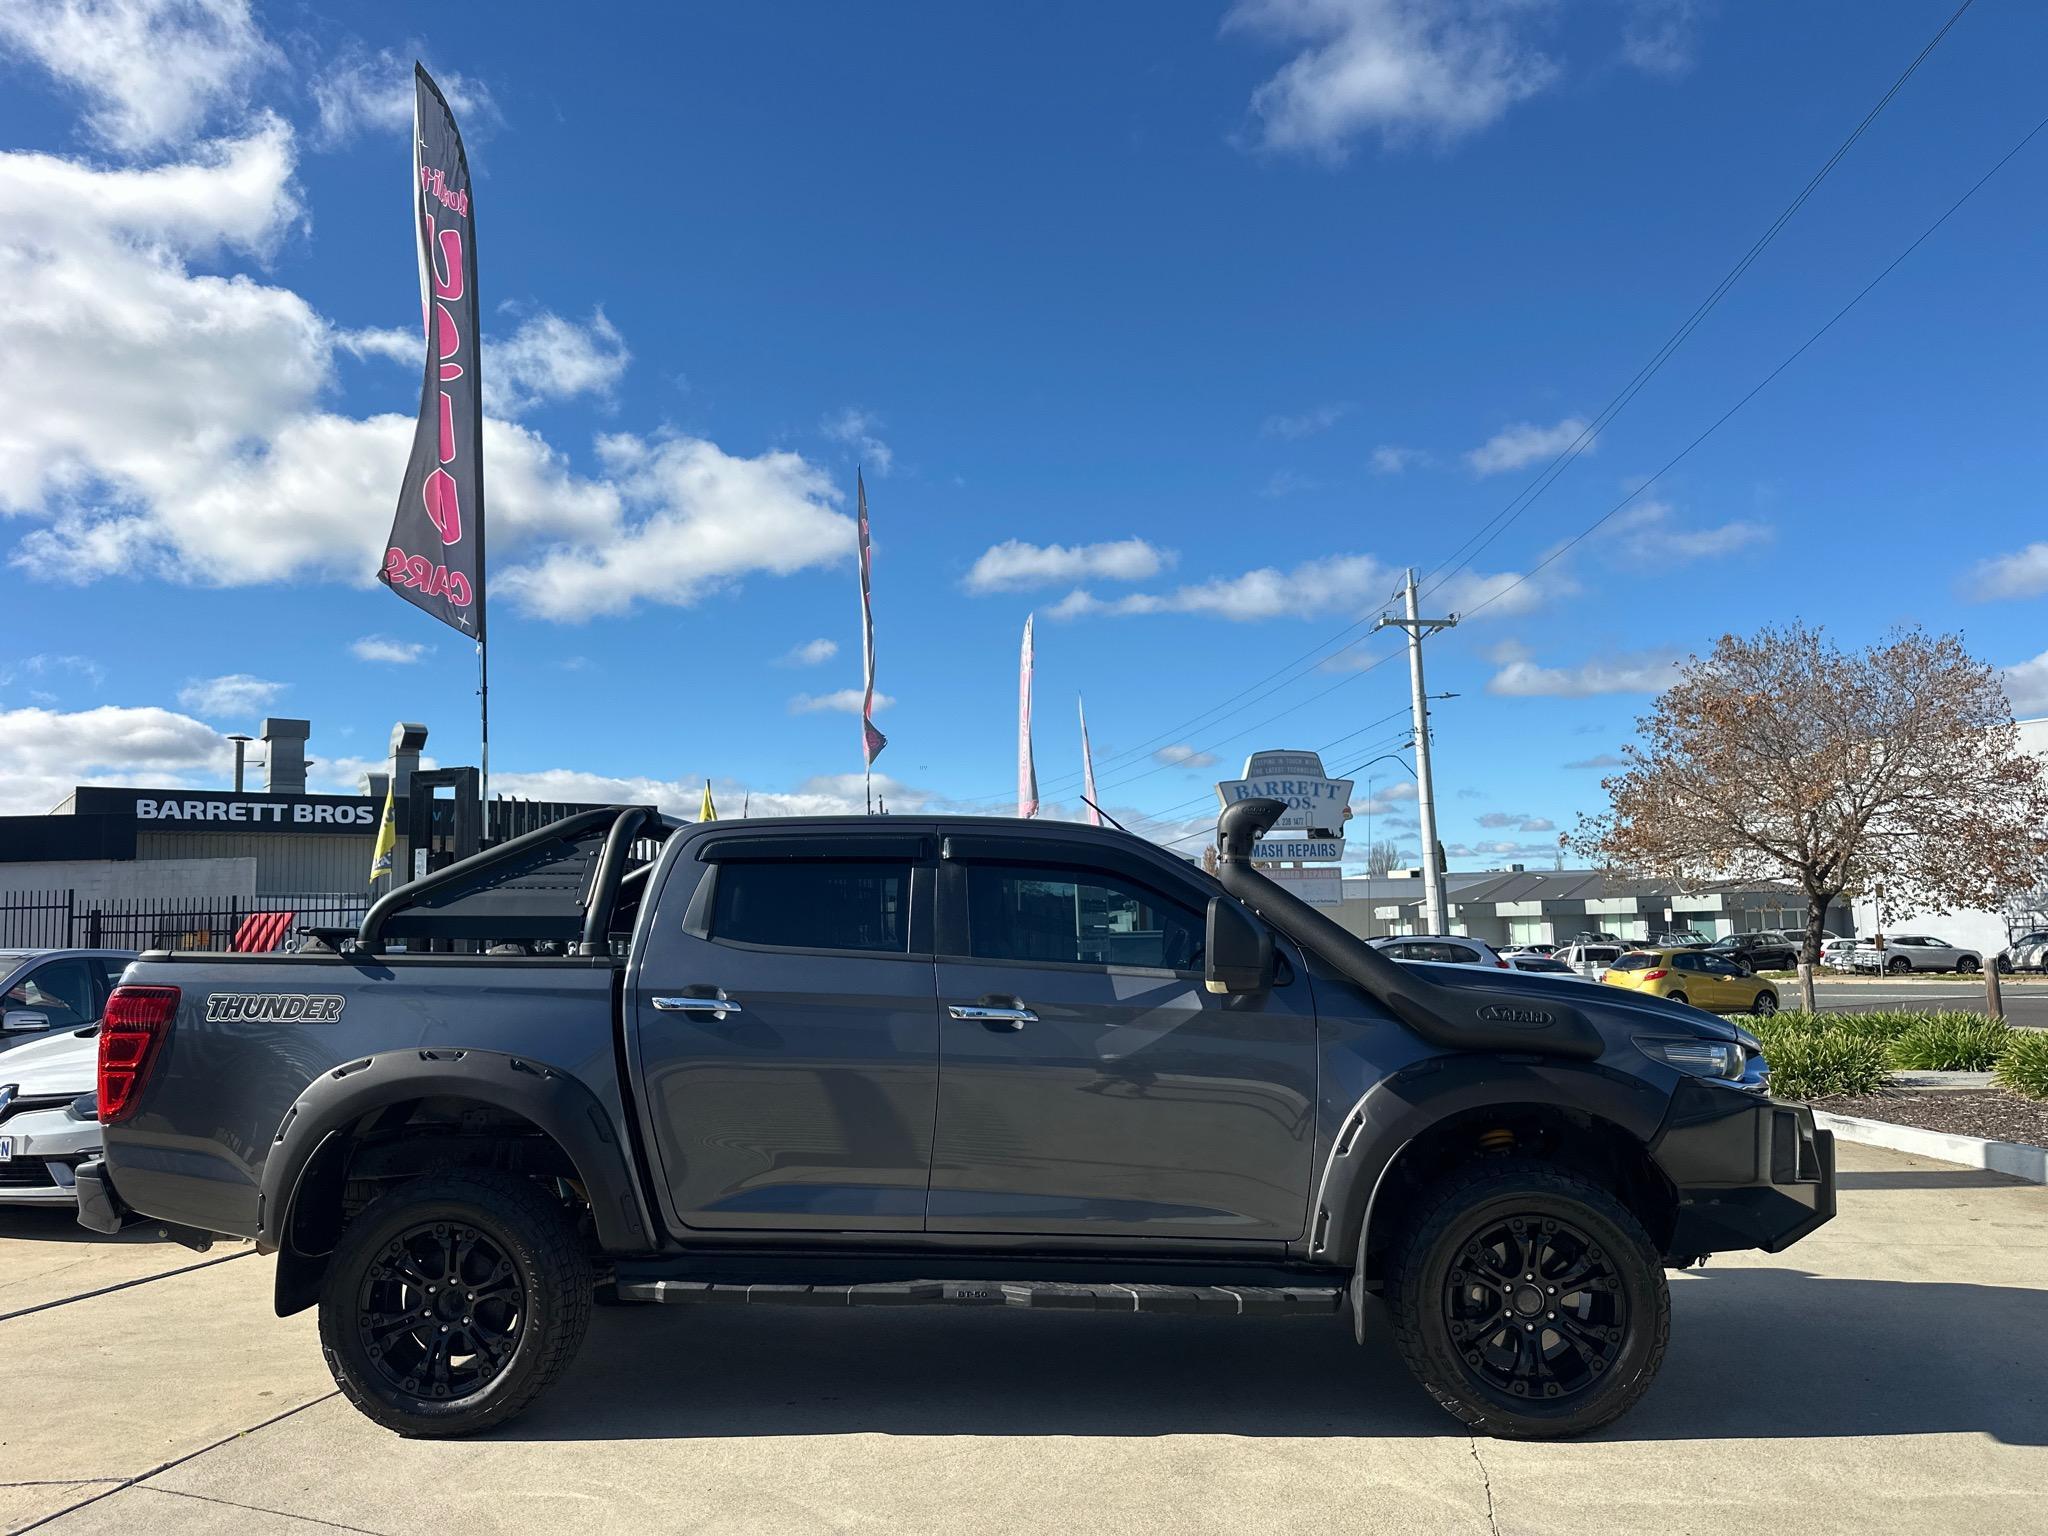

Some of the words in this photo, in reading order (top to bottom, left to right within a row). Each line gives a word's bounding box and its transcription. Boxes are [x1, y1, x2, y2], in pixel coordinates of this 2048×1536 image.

[1234, 780, 1341, 800] BARRETT
[136, 799, 288, 822] BARRETT
[293, 804, 374, 824] BROS
[1251, 843, 1283, 858] MASH
[1287, 843, 1337, 857] REPAIRS
[206, 993, 345, 1023] THUNDER
[956, 1290, 988, 1299] BT-50
